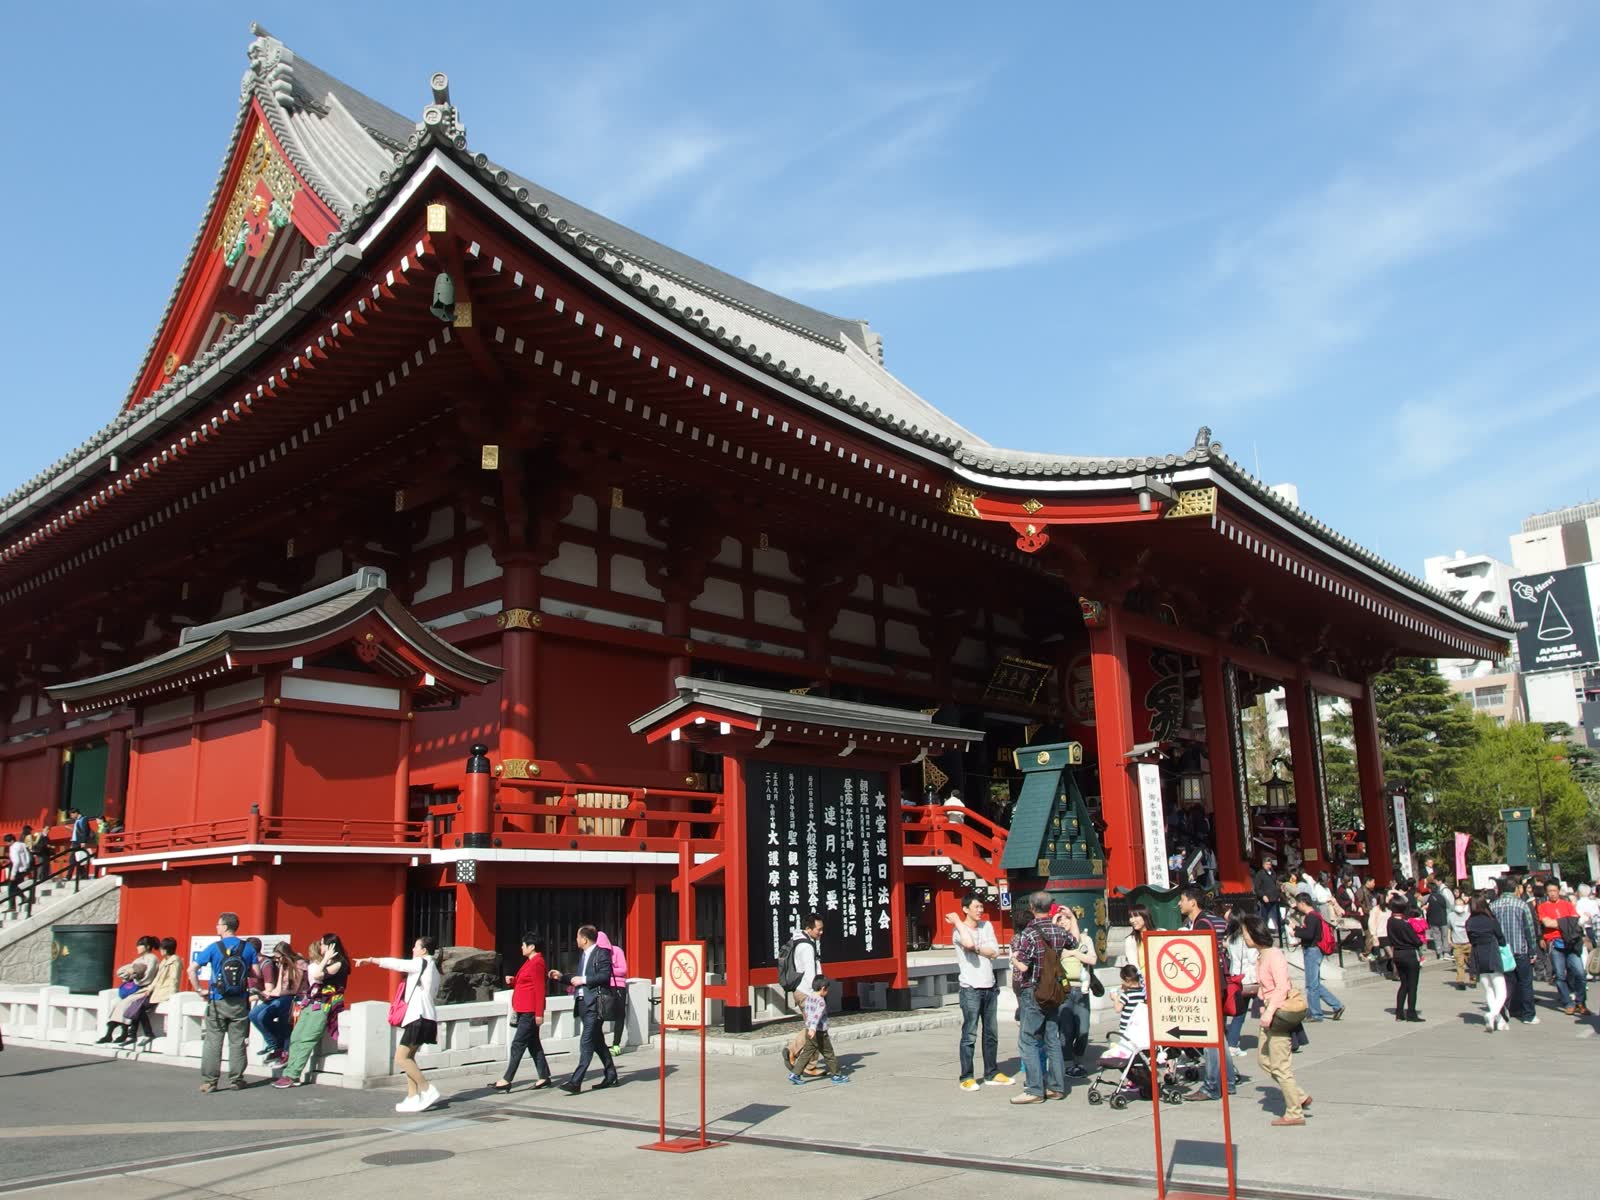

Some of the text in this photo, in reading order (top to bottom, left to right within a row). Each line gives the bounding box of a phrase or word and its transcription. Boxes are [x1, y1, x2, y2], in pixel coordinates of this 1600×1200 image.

[1534, 575, 1556, 593] Here!
[1539, 644, 1577, 655] AMUSE
[1536, 650, 1582, 663] MUSEUM
[824, 805, 838, 911] 連月法要
[874, 791, 890, 930] 本堂連日法会
[767, 829, 781, 906] 大護摩供
[671, 993, 695, 1005] 自転車
[1159, 995, 1208, 1004] 自転車の方は
[666, 1009, 699, 1021] 進入禁止
